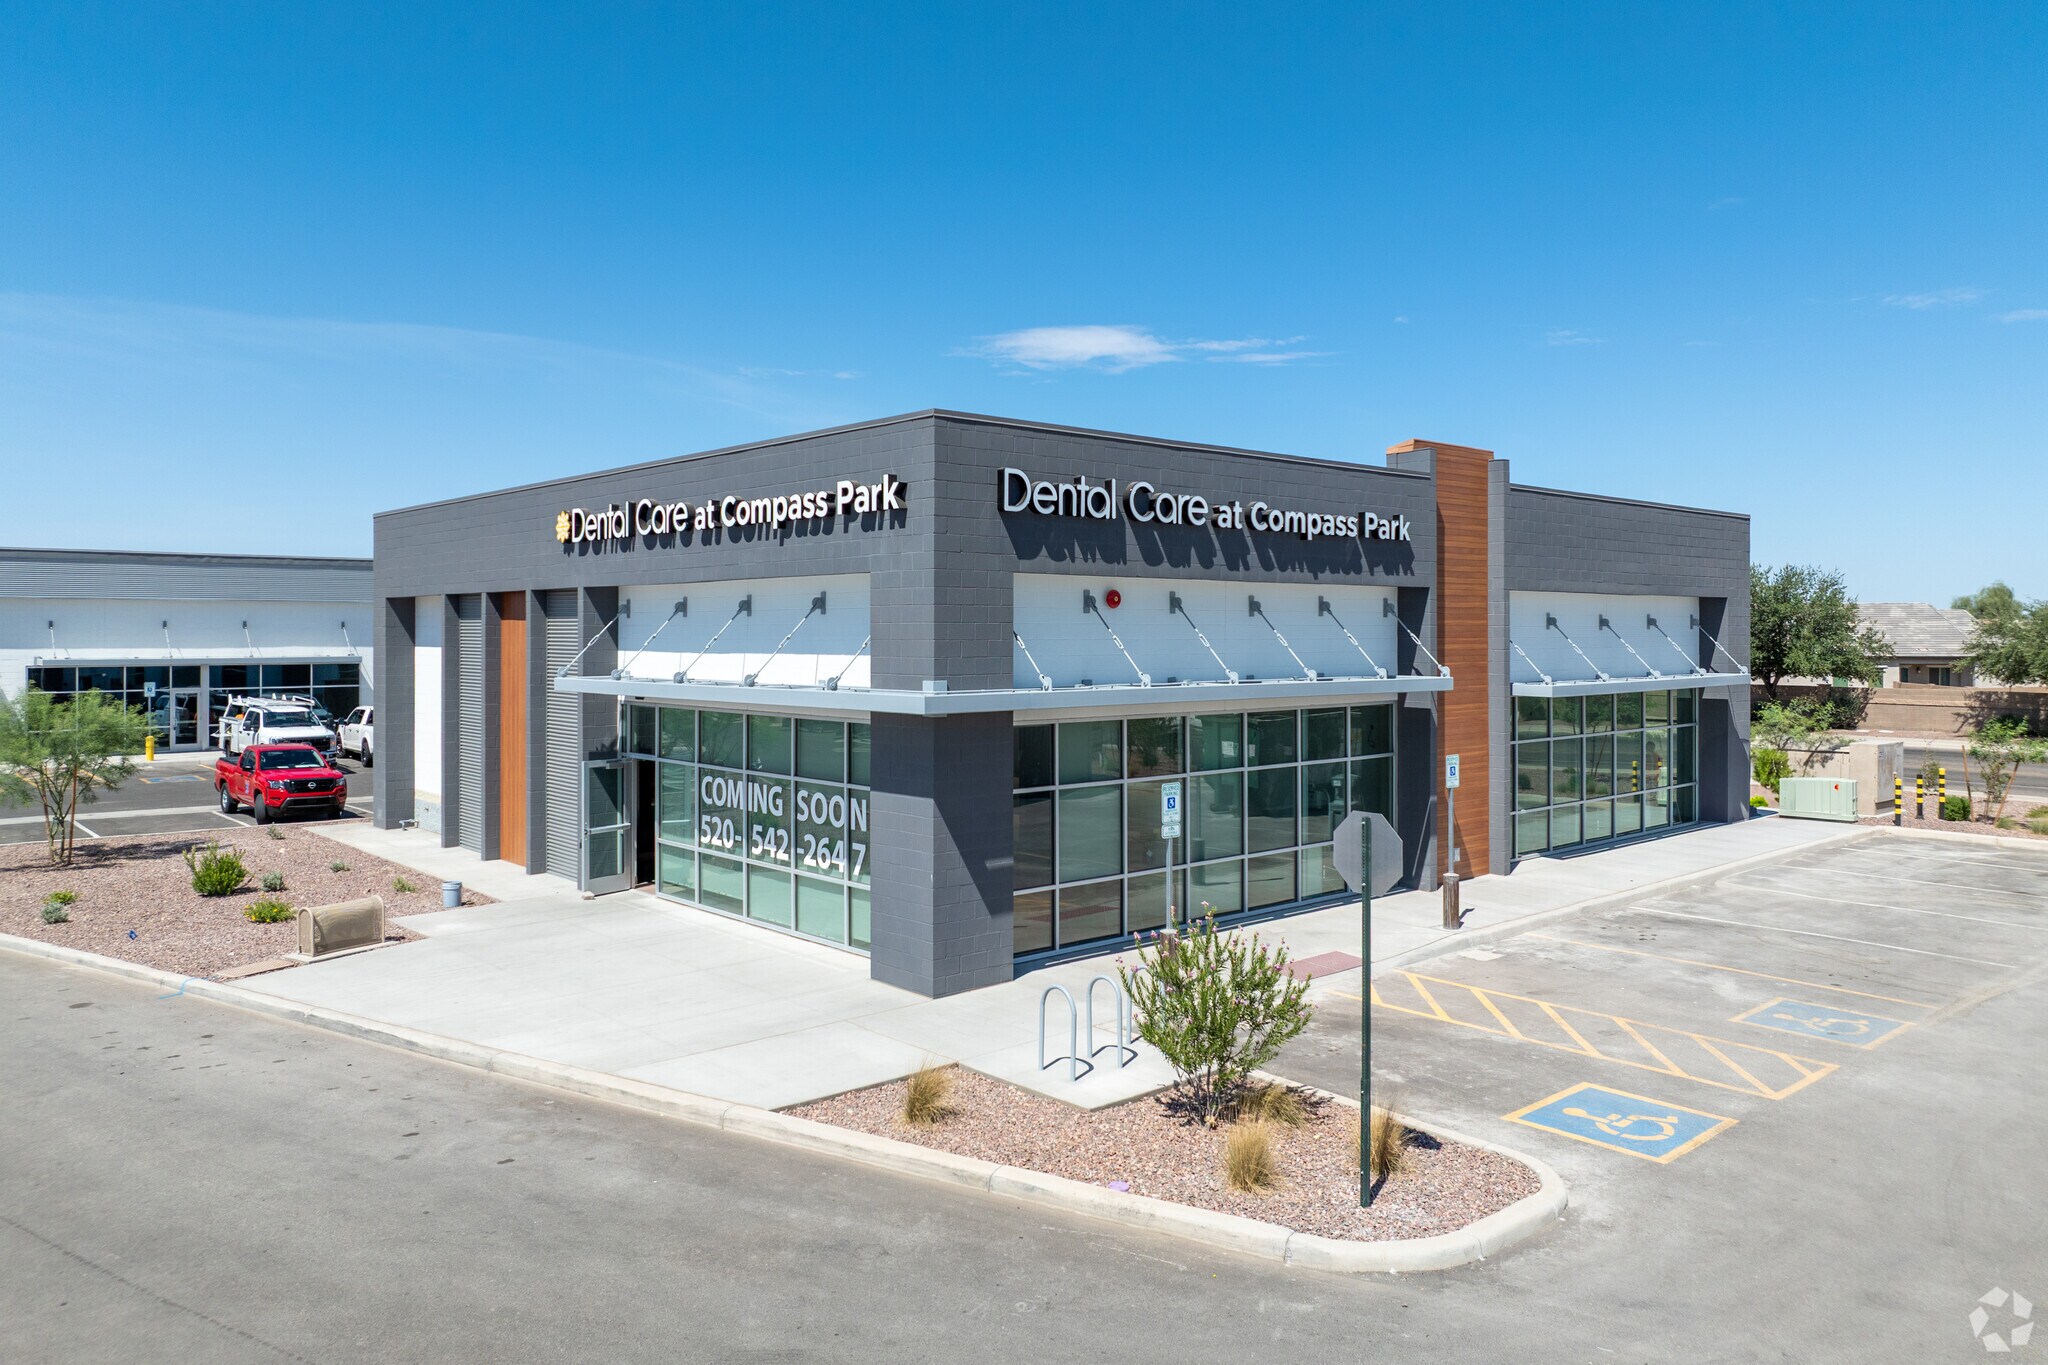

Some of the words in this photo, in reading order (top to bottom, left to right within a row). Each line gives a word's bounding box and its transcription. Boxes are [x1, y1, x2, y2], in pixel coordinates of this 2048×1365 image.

[572, 499, 629, 543] Dental
[636, 499, 687, 535] Care
[694, 500, 715, 530] at
[721, 490, 828, 529] Compass
[837, 474, 899, 515] Park
[1003, 468, 1117, 519] Dental
[1128, 481, 1208, 525] Care
[1217, 502, 1242, 529] at
[1250, 502, 1358, 540] Compass
[1365, 512, 1411, 541] Park
[701, 776, 783, 816] COMING
[797, 790, 867, 832] SOON
